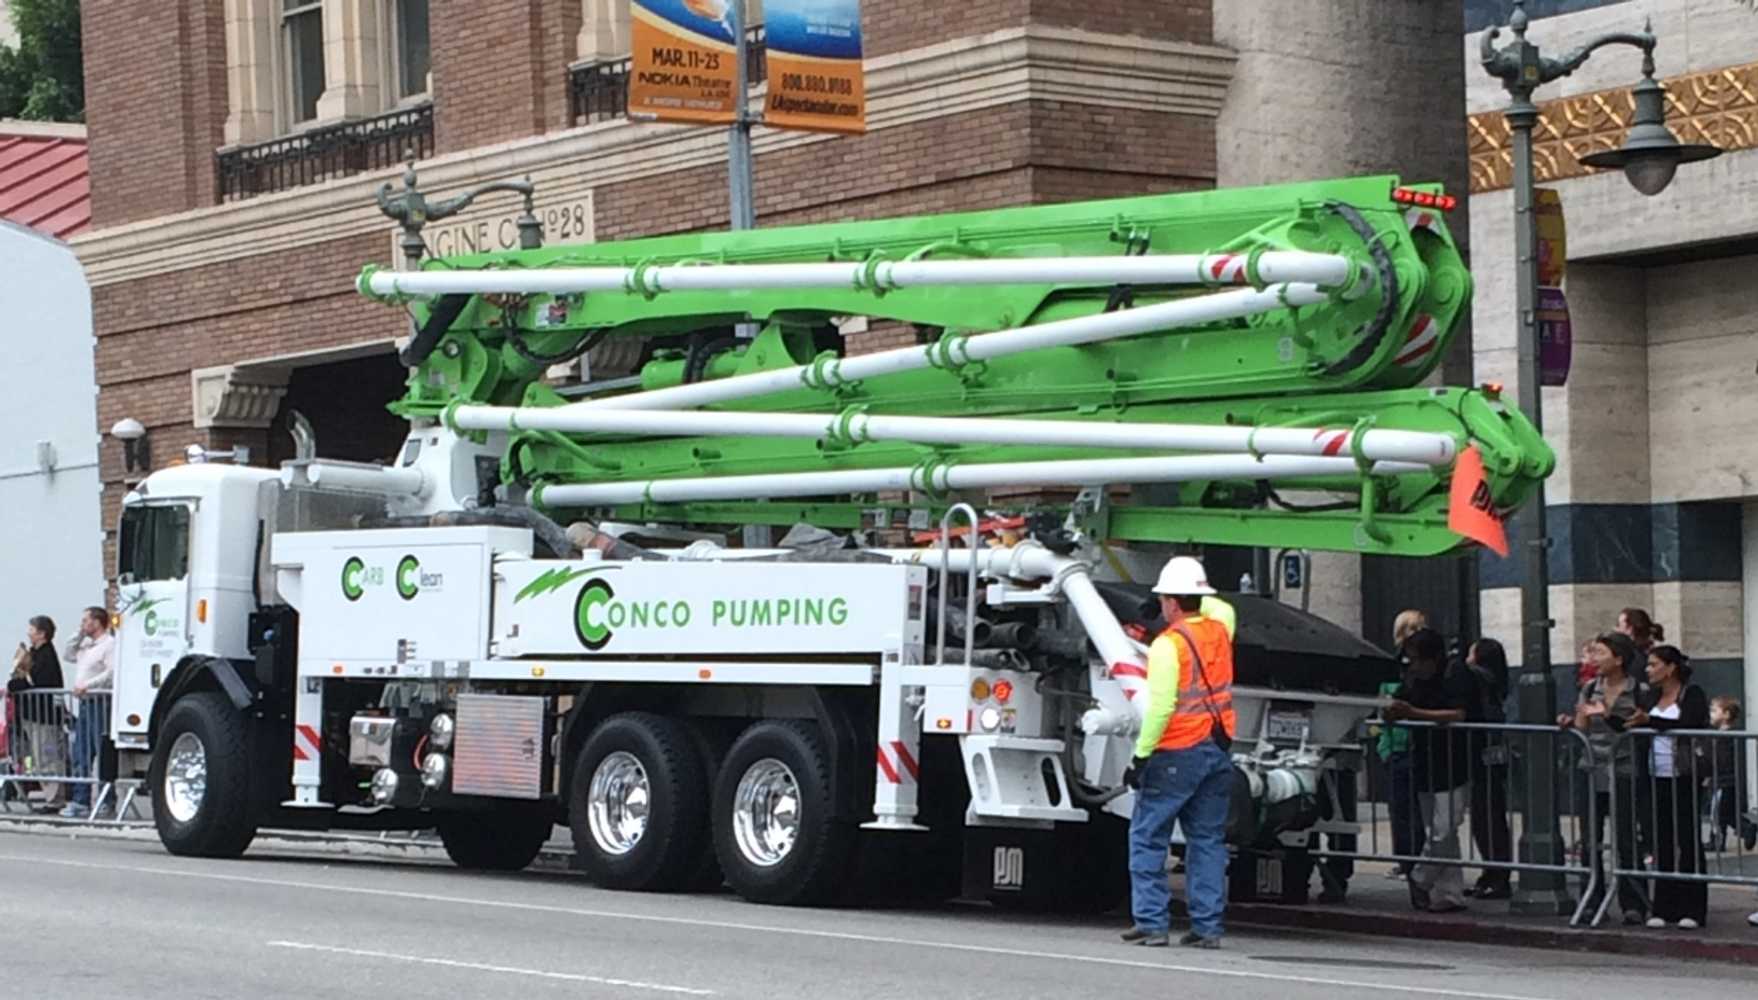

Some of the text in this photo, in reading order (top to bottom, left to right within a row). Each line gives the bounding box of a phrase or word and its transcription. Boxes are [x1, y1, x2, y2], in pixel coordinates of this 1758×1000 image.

[638, 71, 691, 87] NOKIA
[419, 221, 492, 258] NGINE
[396, 554, 443, 601] Clean
[573, 577, 691, 652] CONCO
[712, 597, 849, 627] PUMPING
